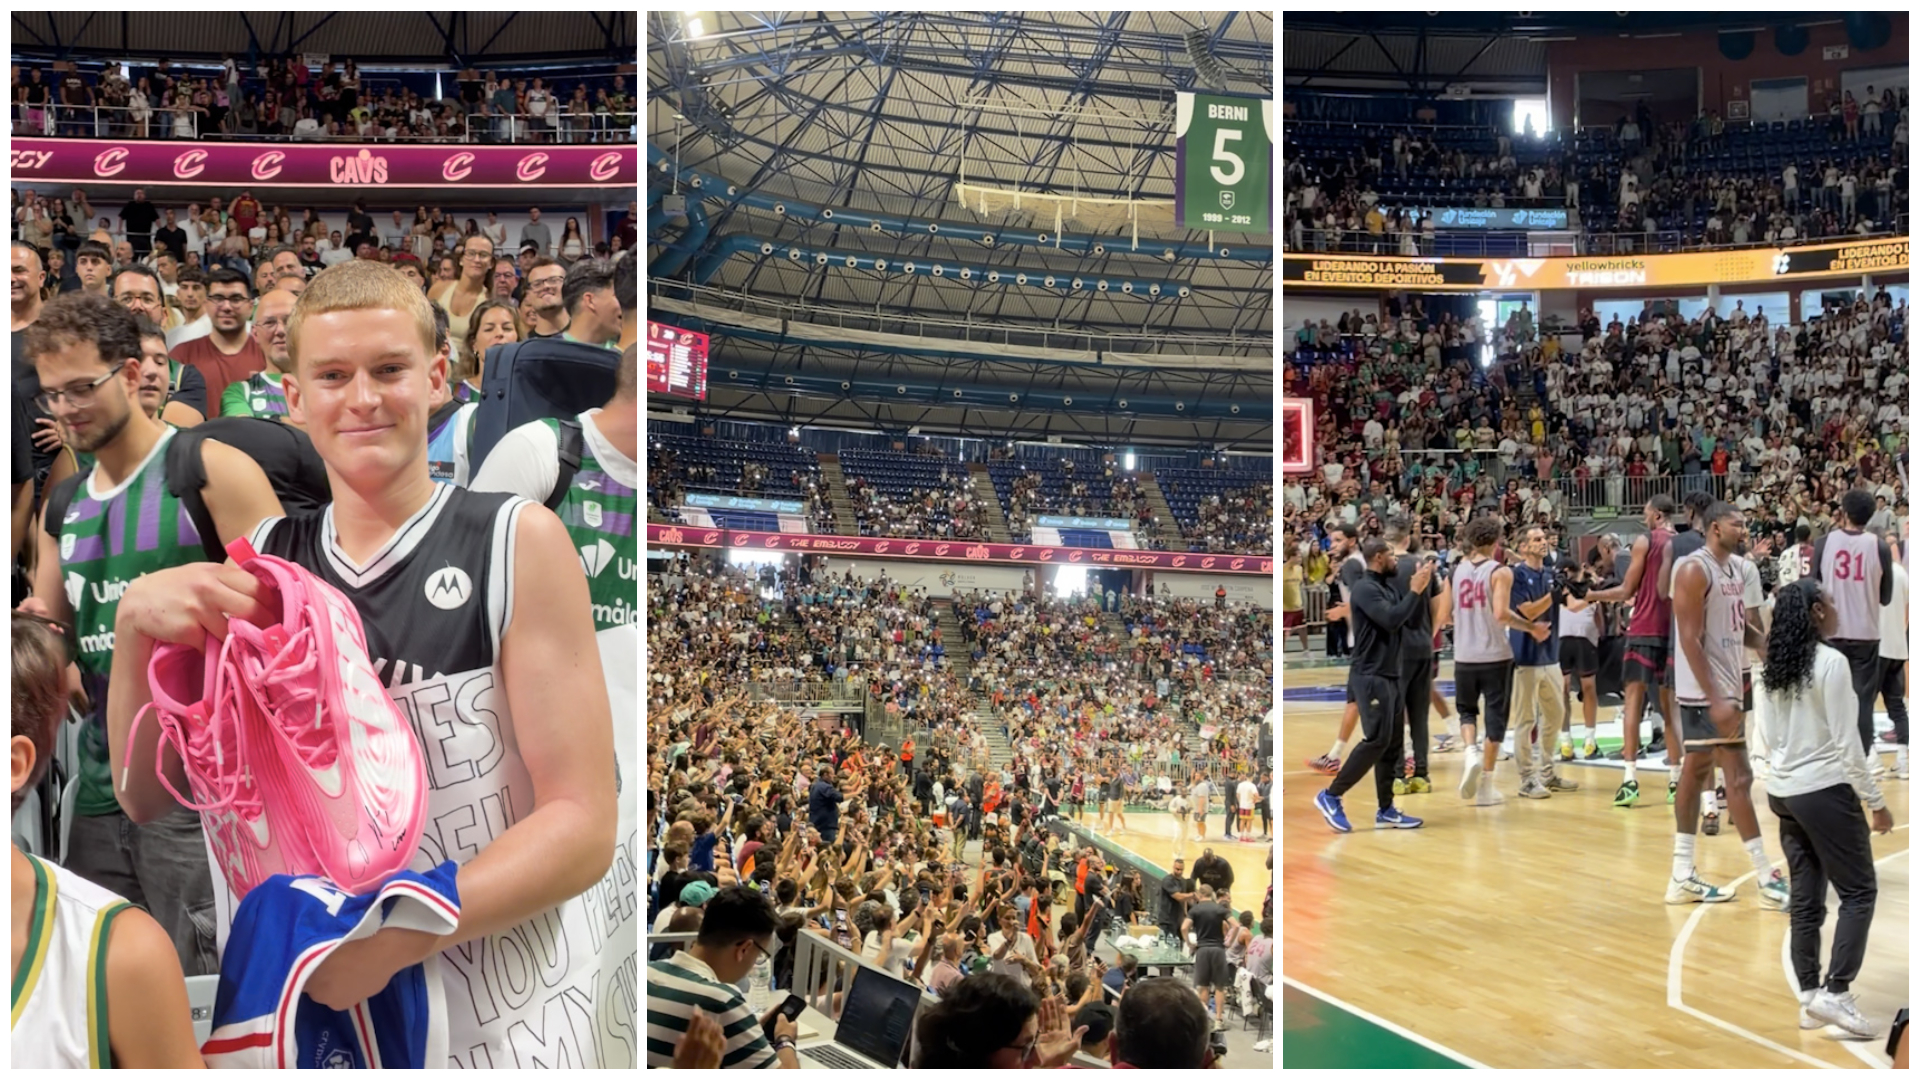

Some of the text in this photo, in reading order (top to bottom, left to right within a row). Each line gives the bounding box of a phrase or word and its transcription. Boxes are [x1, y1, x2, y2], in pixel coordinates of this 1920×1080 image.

[1208, 104, 1248, 121] BERNI
[1210, 128, 1245, 186] 5
[330, 149, 388, 184] CAVS
[1231, 215, 1251, 224] 2012
[1838, 244, 1902, 259] LIDERANDO
[1313, 261, 1435, 274] LIDERANDO LA PASIÓN
[1566, 260, 1645, 272] yellowbricks
[1830, 260, 1845, 270] EN
[1846, 255, 1897, 269] EVENTOS
[1304, 271, 1444, 284] EN EVENTOS DEPORTIVOS
[659, 528, 684, 544] CAVS
[790, 538, 810, 547] THE
[812, 539, 860, 550] EMBASSY
[966, 544, 990, 559] CAVS
[1092, 553, 1110, 562] THE
[1113, 554, 1159, 564] EMBASSY
[1834, 549, 1865, 581] 31
[1460, 578, 1486, 608] 24
